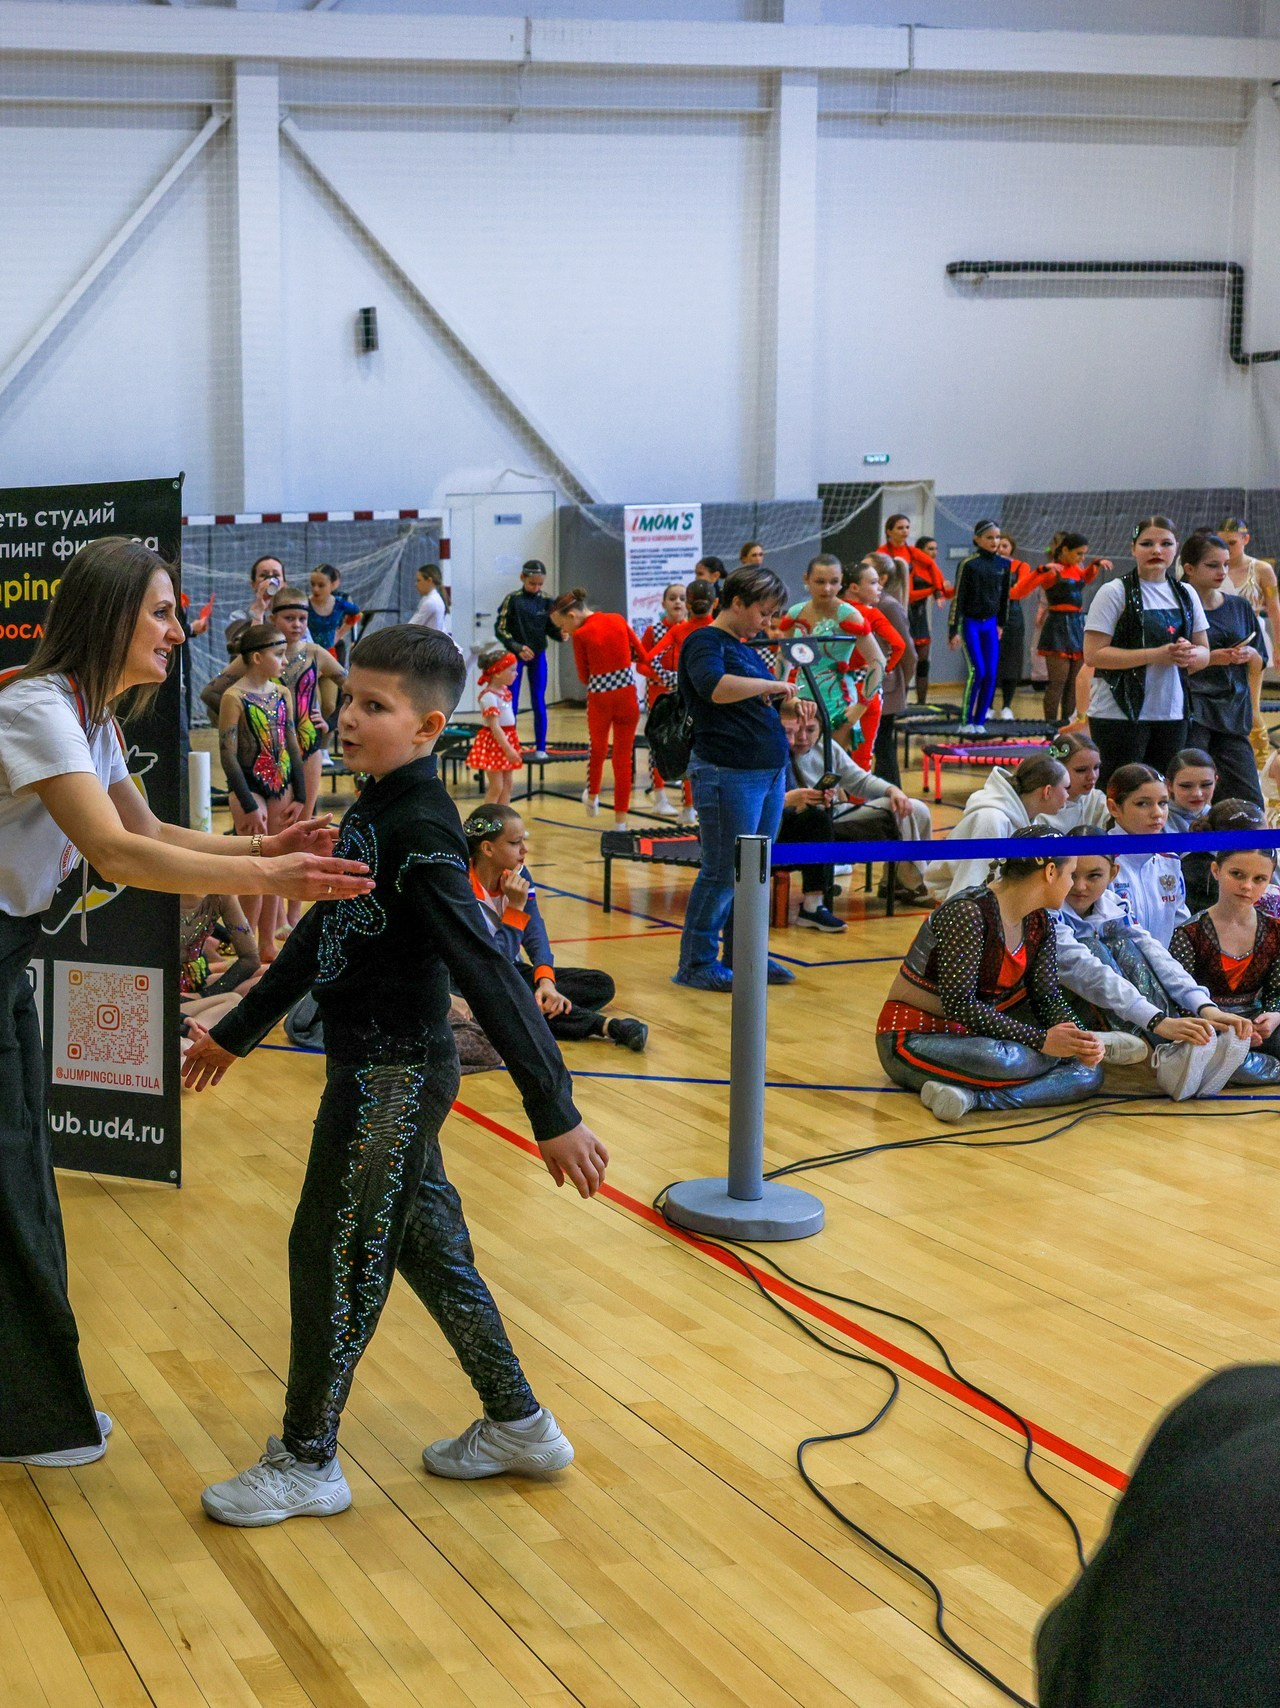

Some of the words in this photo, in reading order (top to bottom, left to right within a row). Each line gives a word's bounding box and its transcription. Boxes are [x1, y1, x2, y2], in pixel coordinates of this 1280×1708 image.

[34, 501, 115, 530] студий
[56, 1067, 160, 1089] @JUMPINGCLUB.TULA
[276, 1480, 298, 1499] FILA
